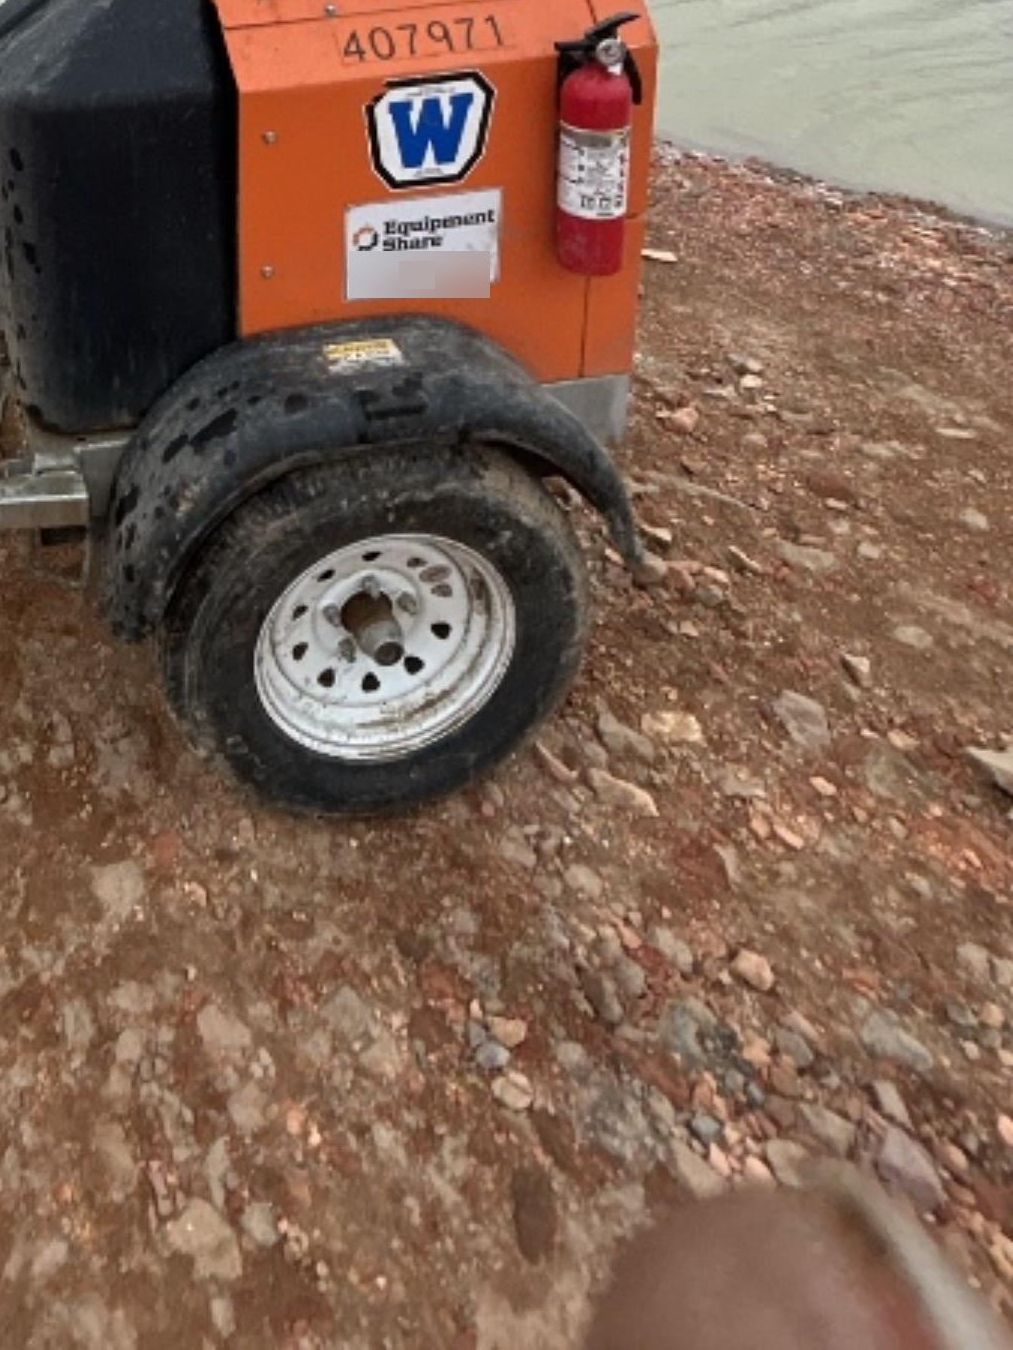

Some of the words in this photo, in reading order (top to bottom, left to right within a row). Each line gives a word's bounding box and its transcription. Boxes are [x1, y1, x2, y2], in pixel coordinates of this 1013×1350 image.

[343, 15, 504, 62] 407971
[389, 93, 474, 168] W
[383, 209, 495, 237] Equipment
[382, 235, 443, 251] Share
